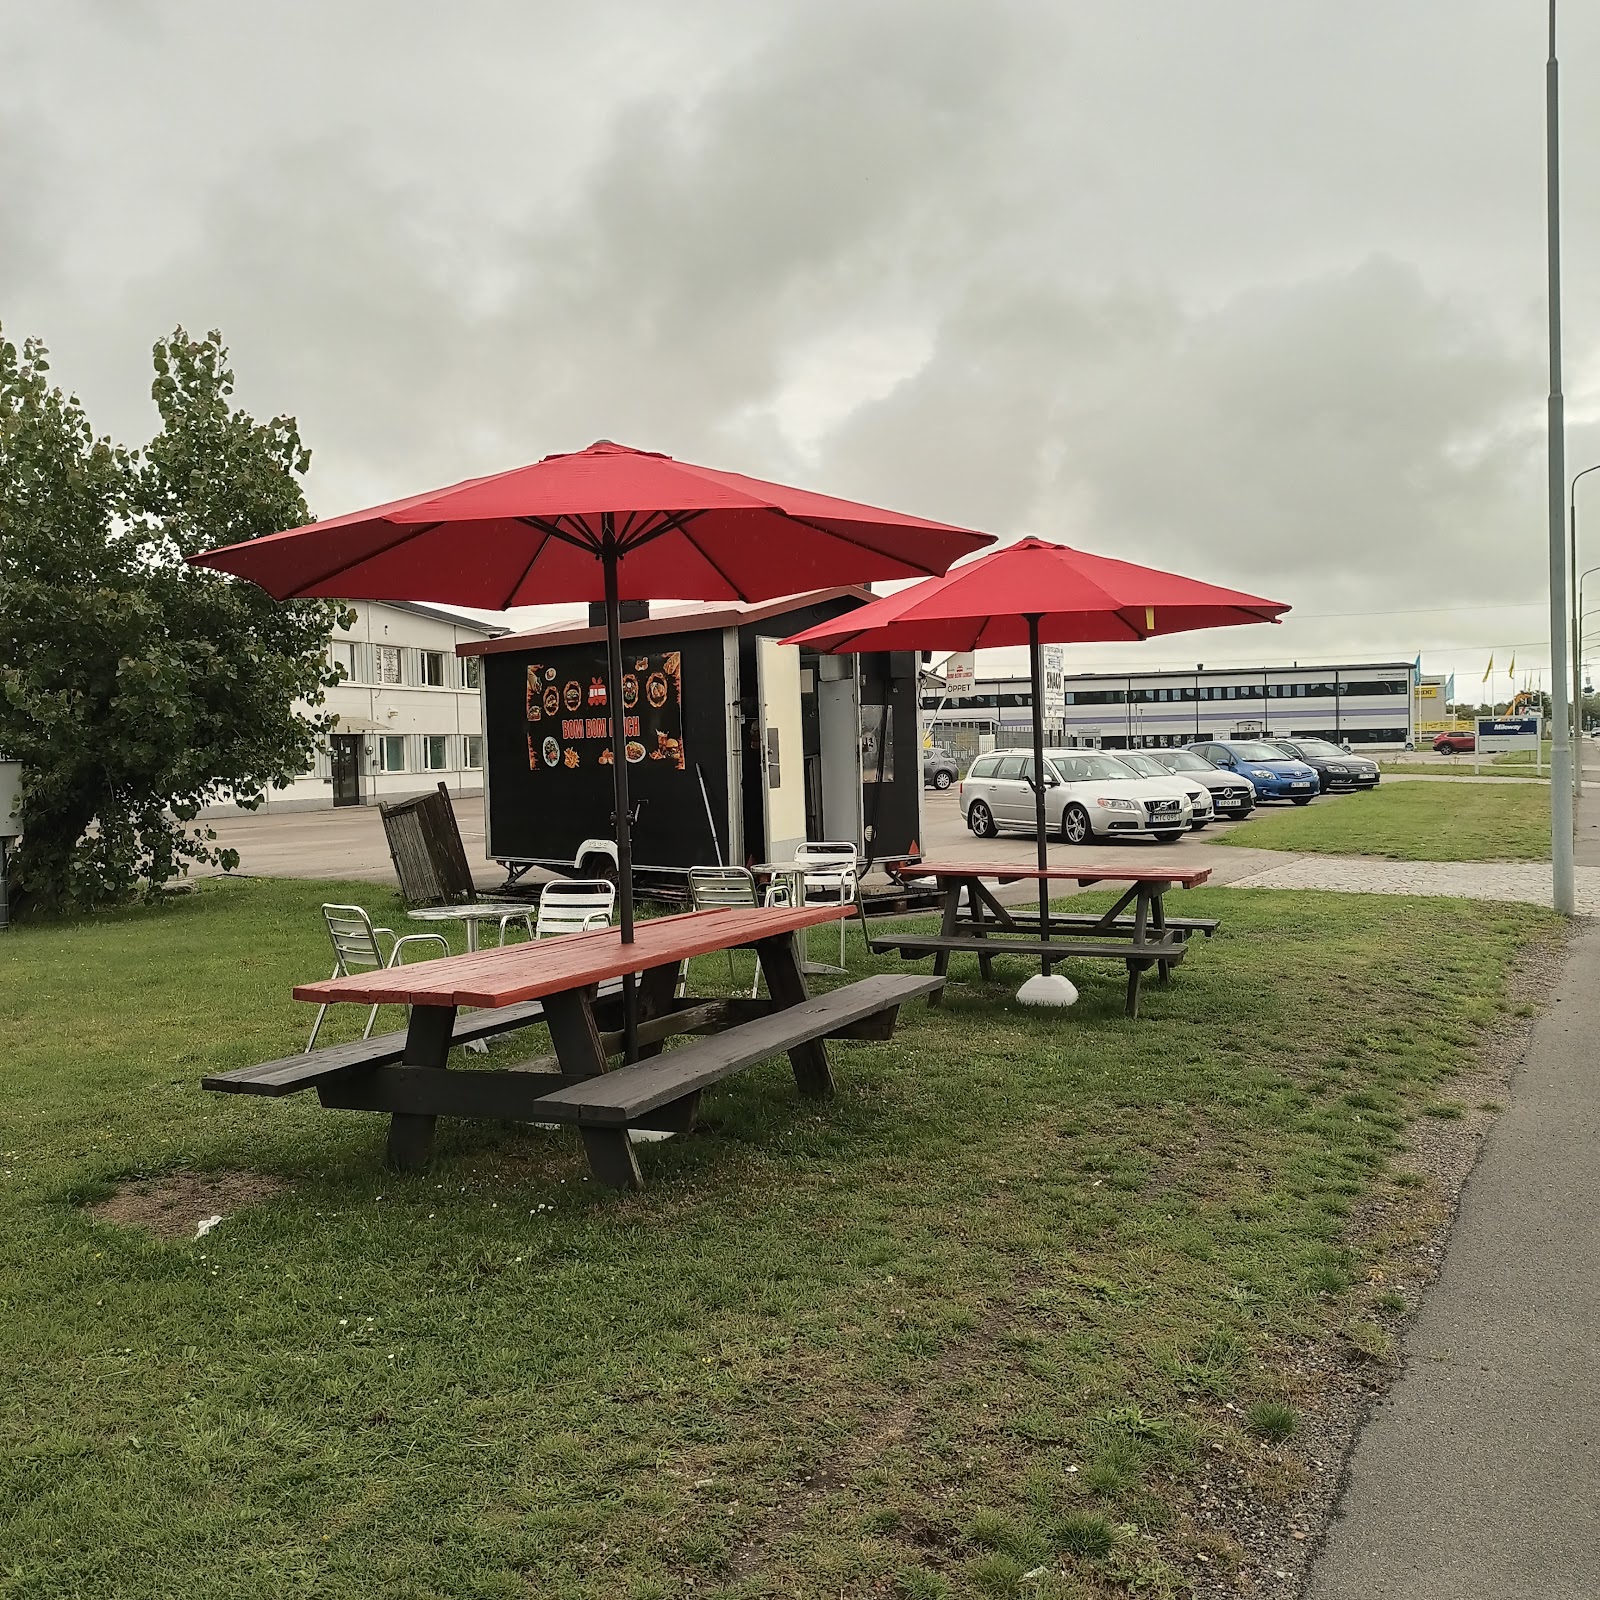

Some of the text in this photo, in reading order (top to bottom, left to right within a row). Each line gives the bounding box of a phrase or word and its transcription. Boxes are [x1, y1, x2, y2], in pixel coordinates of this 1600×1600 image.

[947, 684, 971, 693] ÖPPET
[562, 720, 584, 739] BOM
[586, 717, 607, 738] BOM
